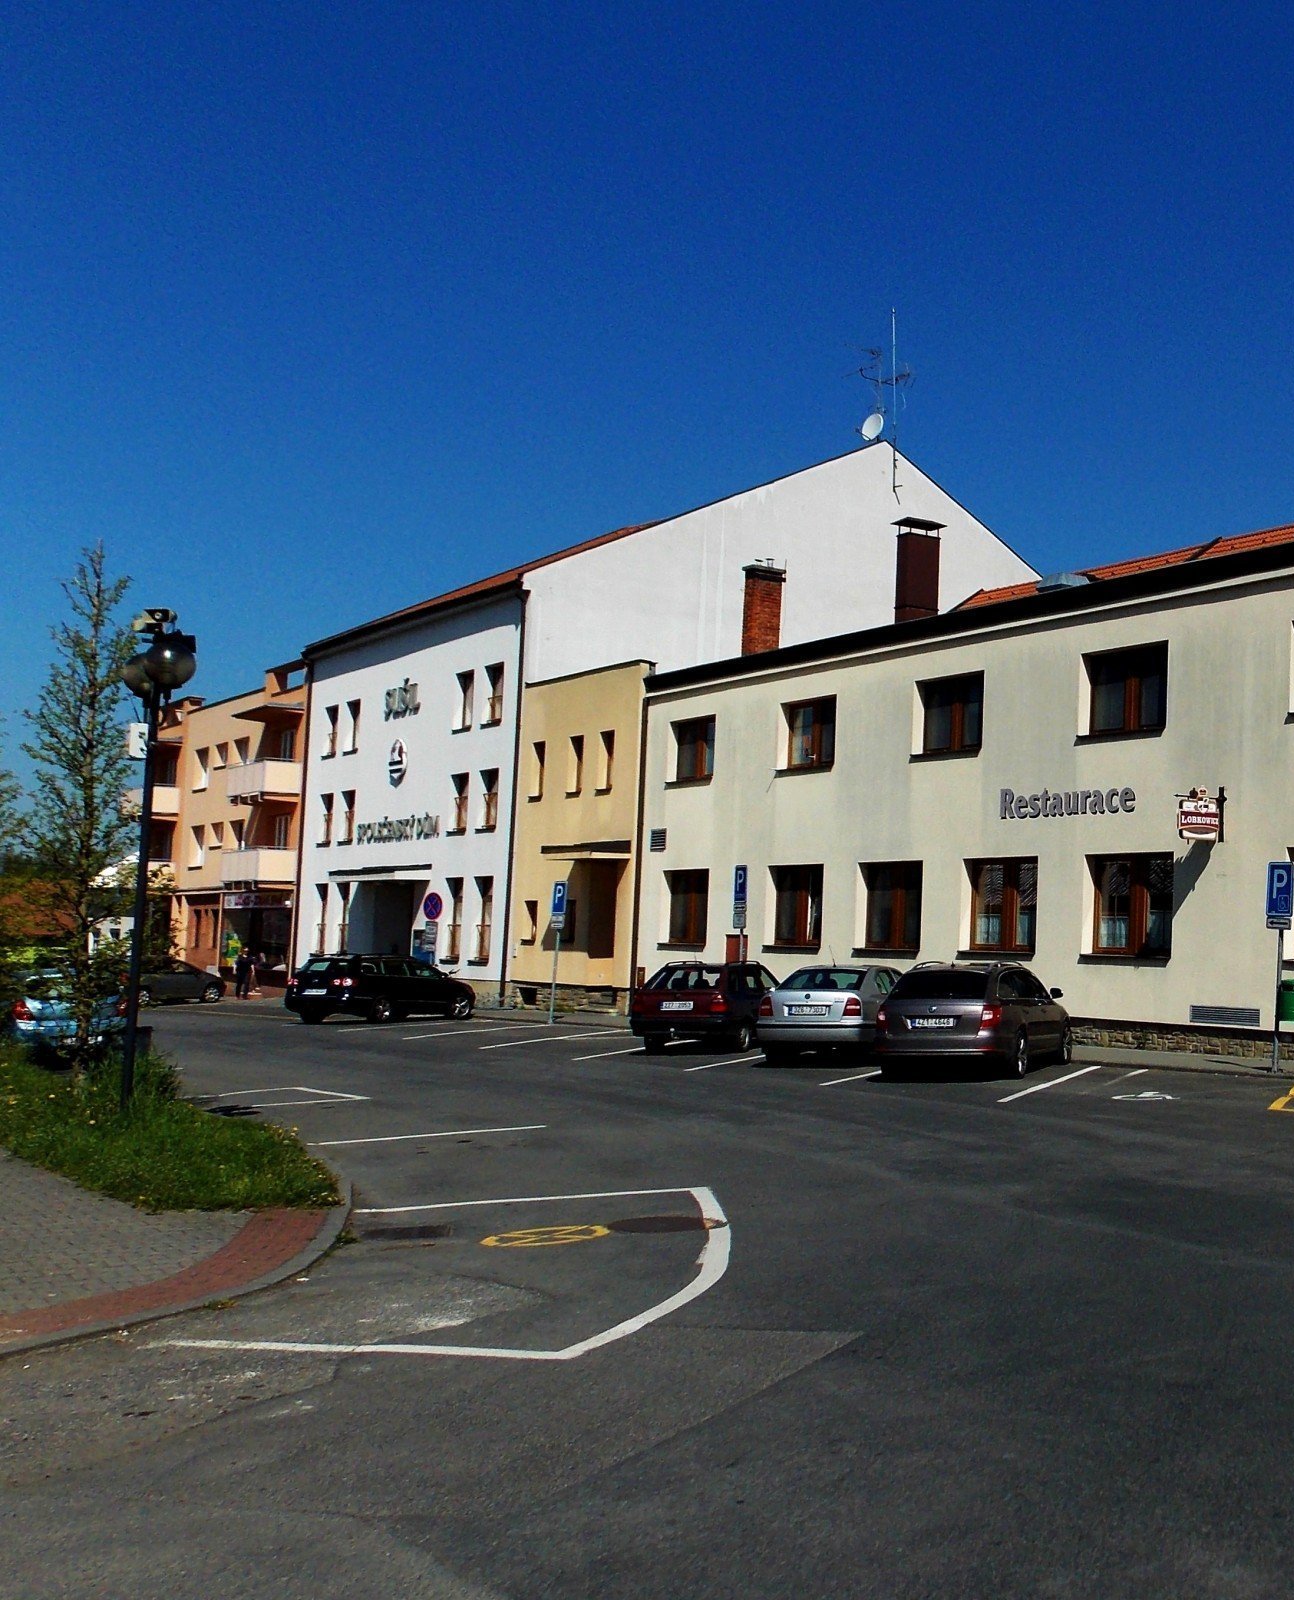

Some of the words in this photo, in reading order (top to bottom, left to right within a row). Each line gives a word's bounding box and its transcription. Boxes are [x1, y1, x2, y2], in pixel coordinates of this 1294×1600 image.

[1000, 787, 1136, 819] Restaurace
[737, 871, 744, 891] P
[1273, 869, 1287, 898] P
[556, 885, 564, 903] P
